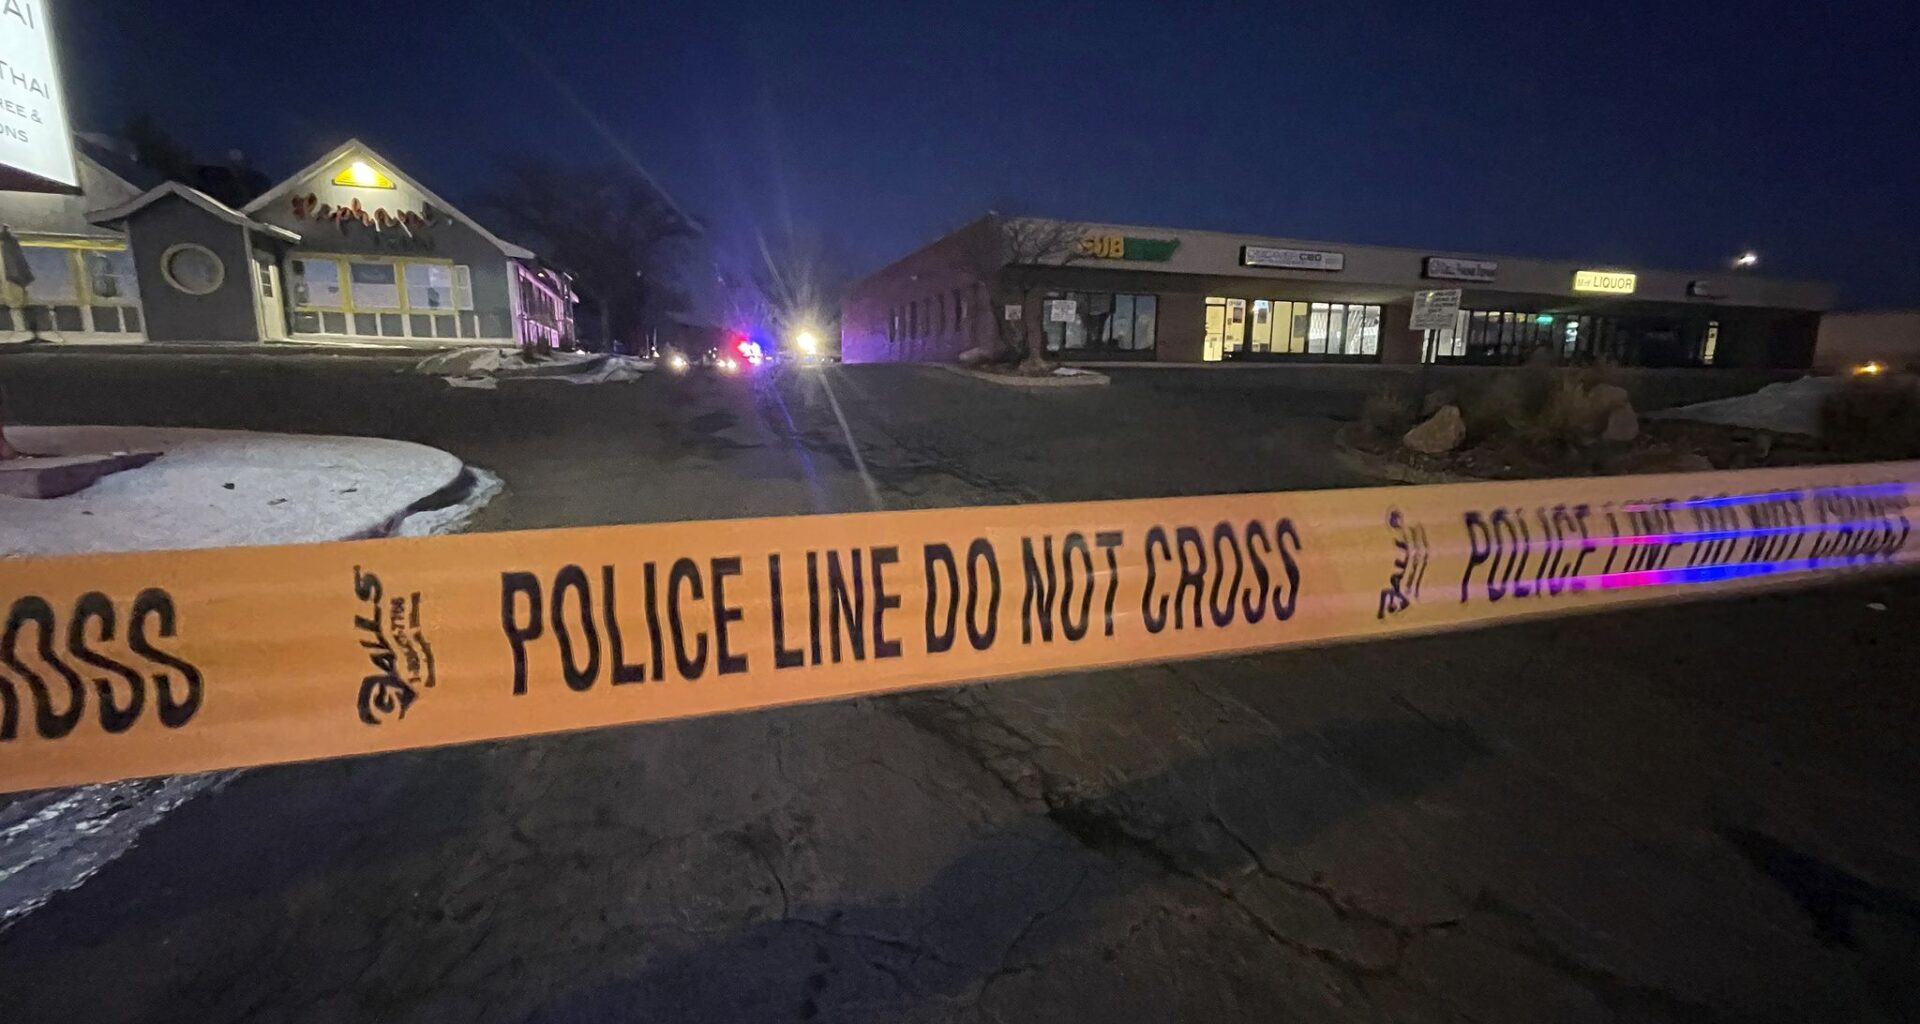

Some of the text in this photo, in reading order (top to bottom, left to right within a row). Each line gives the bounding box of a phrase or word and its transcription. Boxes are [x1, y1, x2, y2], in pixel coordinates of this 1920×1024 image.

[0, 60, 50, 100] THAI
[1078, 236, 1181, 261] SUB
[1593, 275, 1633, 290] LIQUOR
[1460, 503, 1596, 602] POLICE
[501, 556, 749, 696] POLICE
[768, 545, 904, 670] LINE
[924, 537, 1001, 653] DO
[1022, 531, 1124, 645] NOT
[1142, 517, 1303, 634] CROSS
